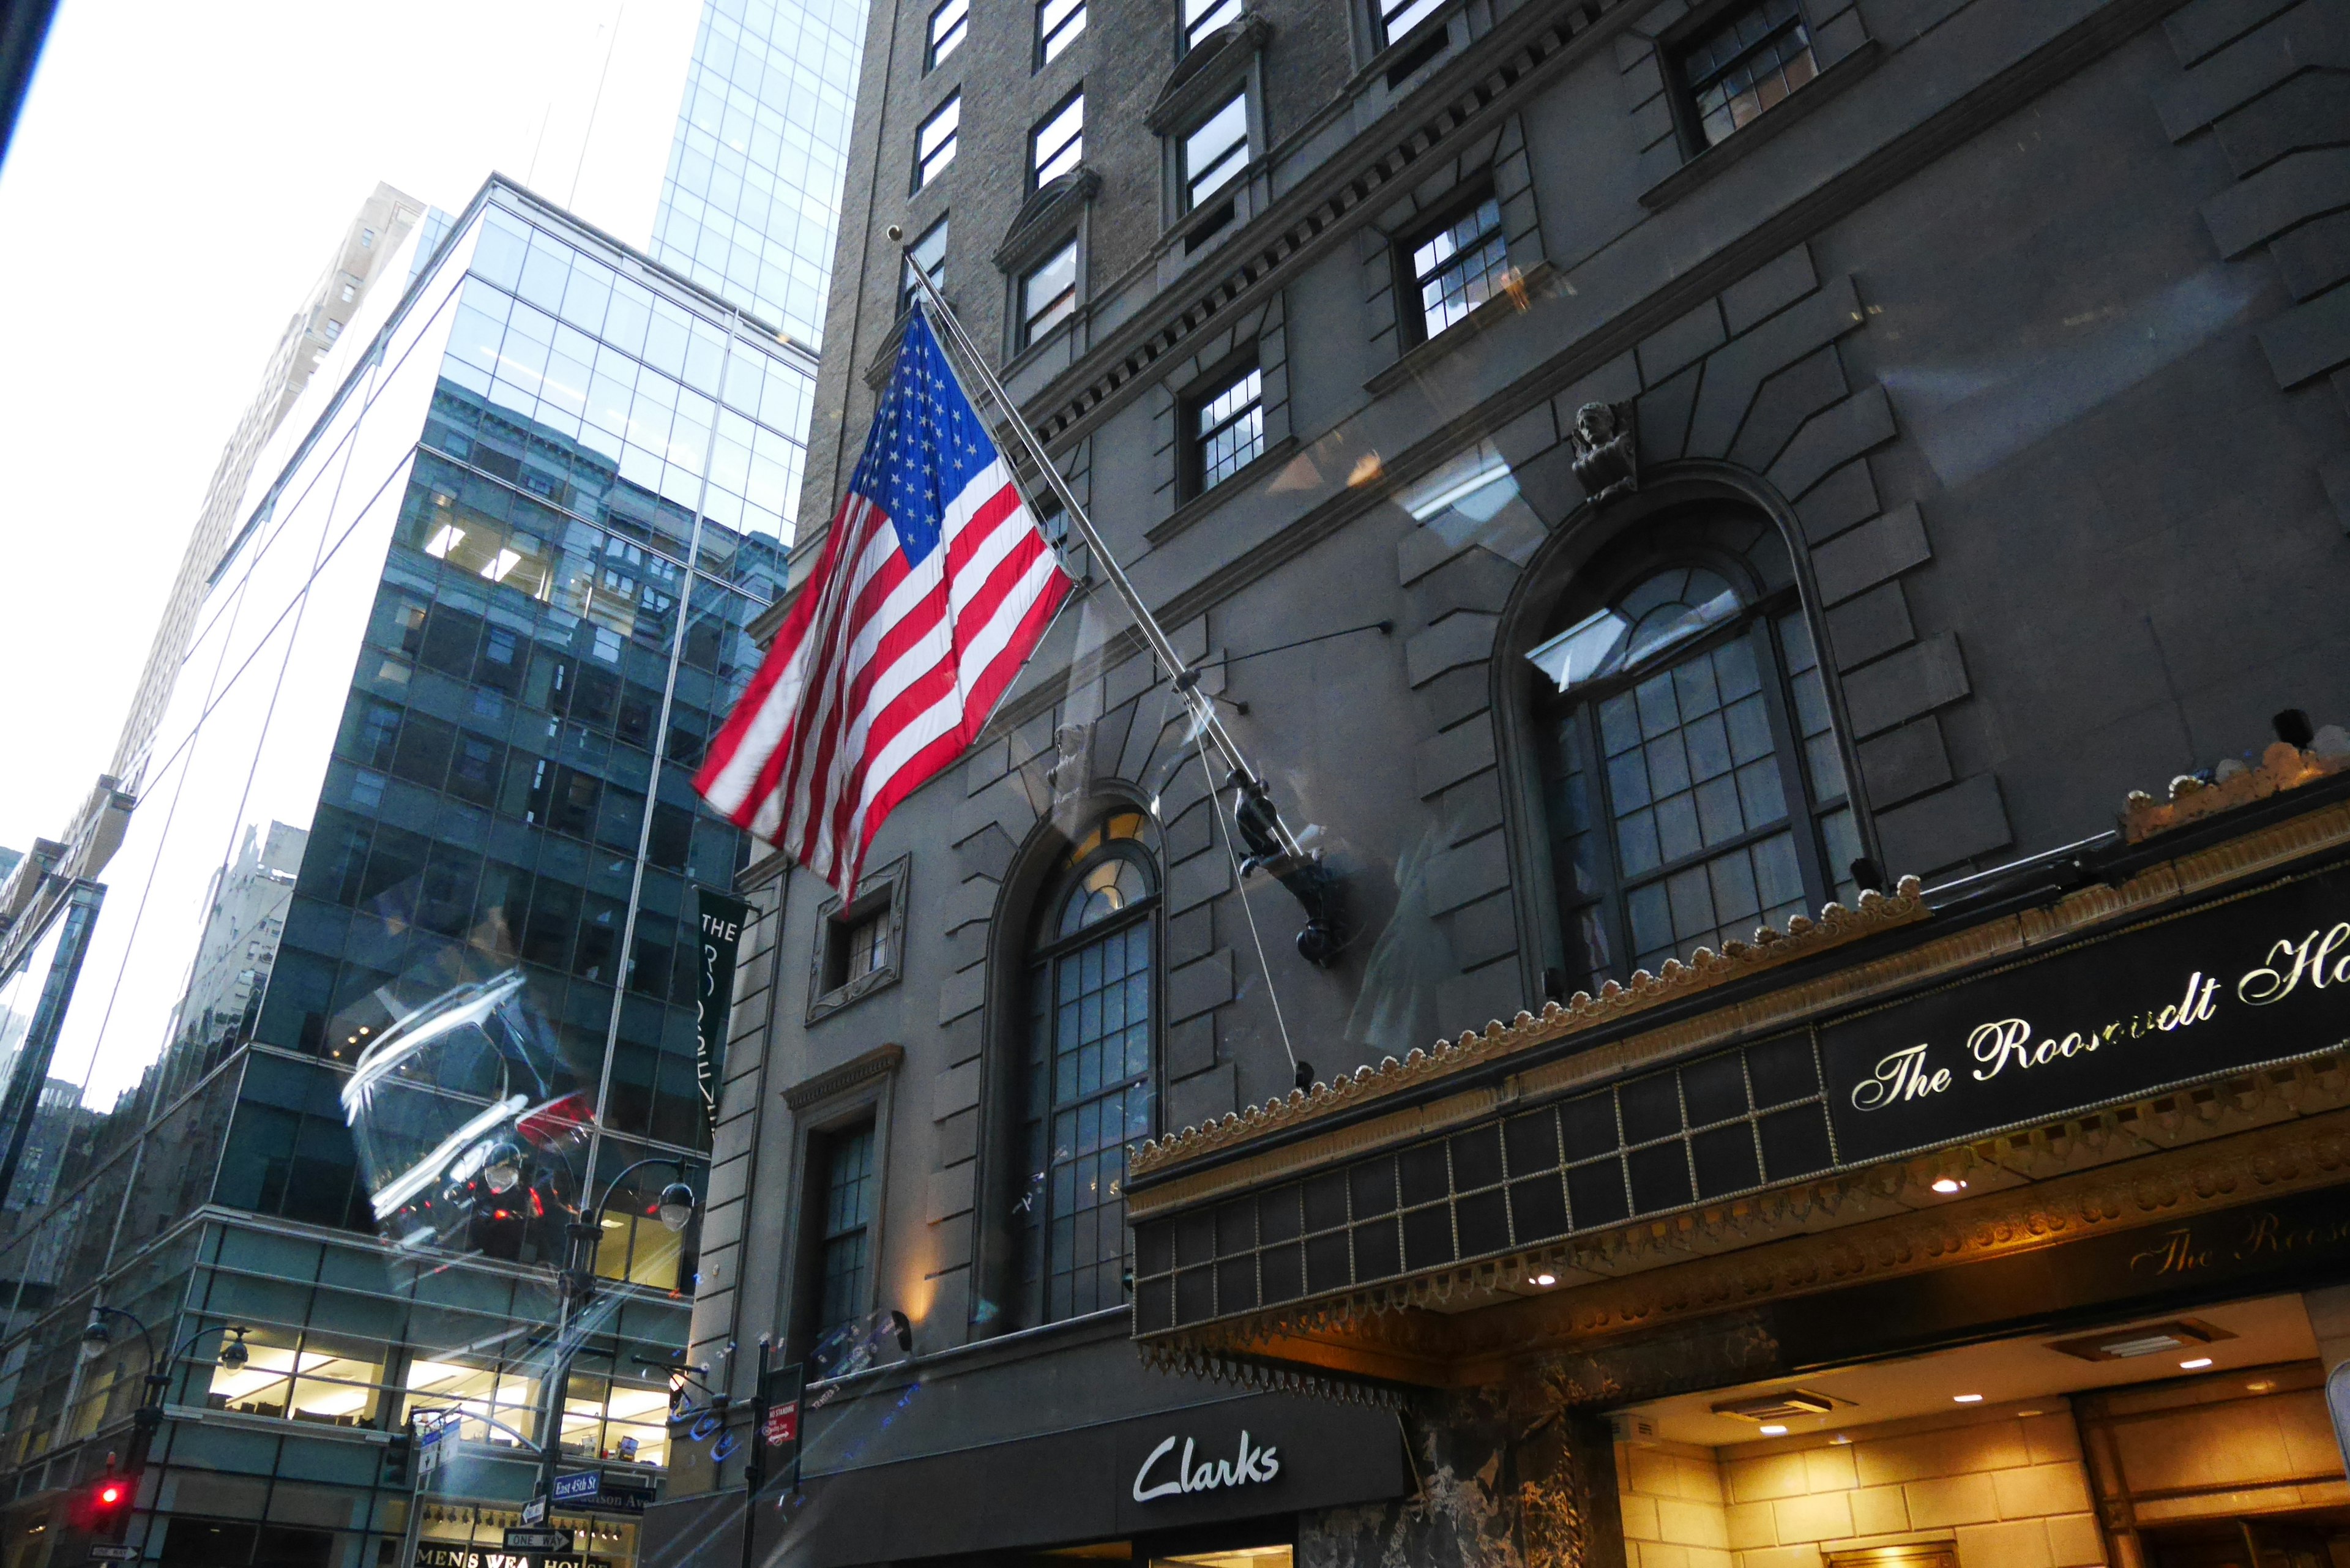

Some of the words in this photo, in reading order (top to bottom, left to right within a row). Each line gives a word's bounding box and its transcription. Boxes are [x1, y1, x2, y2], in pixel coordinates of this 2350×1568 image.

[702, 913, 737, 942] THE
[1851, 1043, 1952, 1111] The
[2130, 1228, 2213, 1277] The
[769, 1409, 776, 1419] NO
[775, 1405, 794, 1417] STANDING
[1133, 1430, 1279, 1502] Clarks
[556, 1482, 570, 1495] East
[571, 1477, 587, 1492] 45th
[588, 1476, 596, 1490] St
[513, 1535, 534, 1546] ONE
[542, 1535, 563, 1547] WAY
